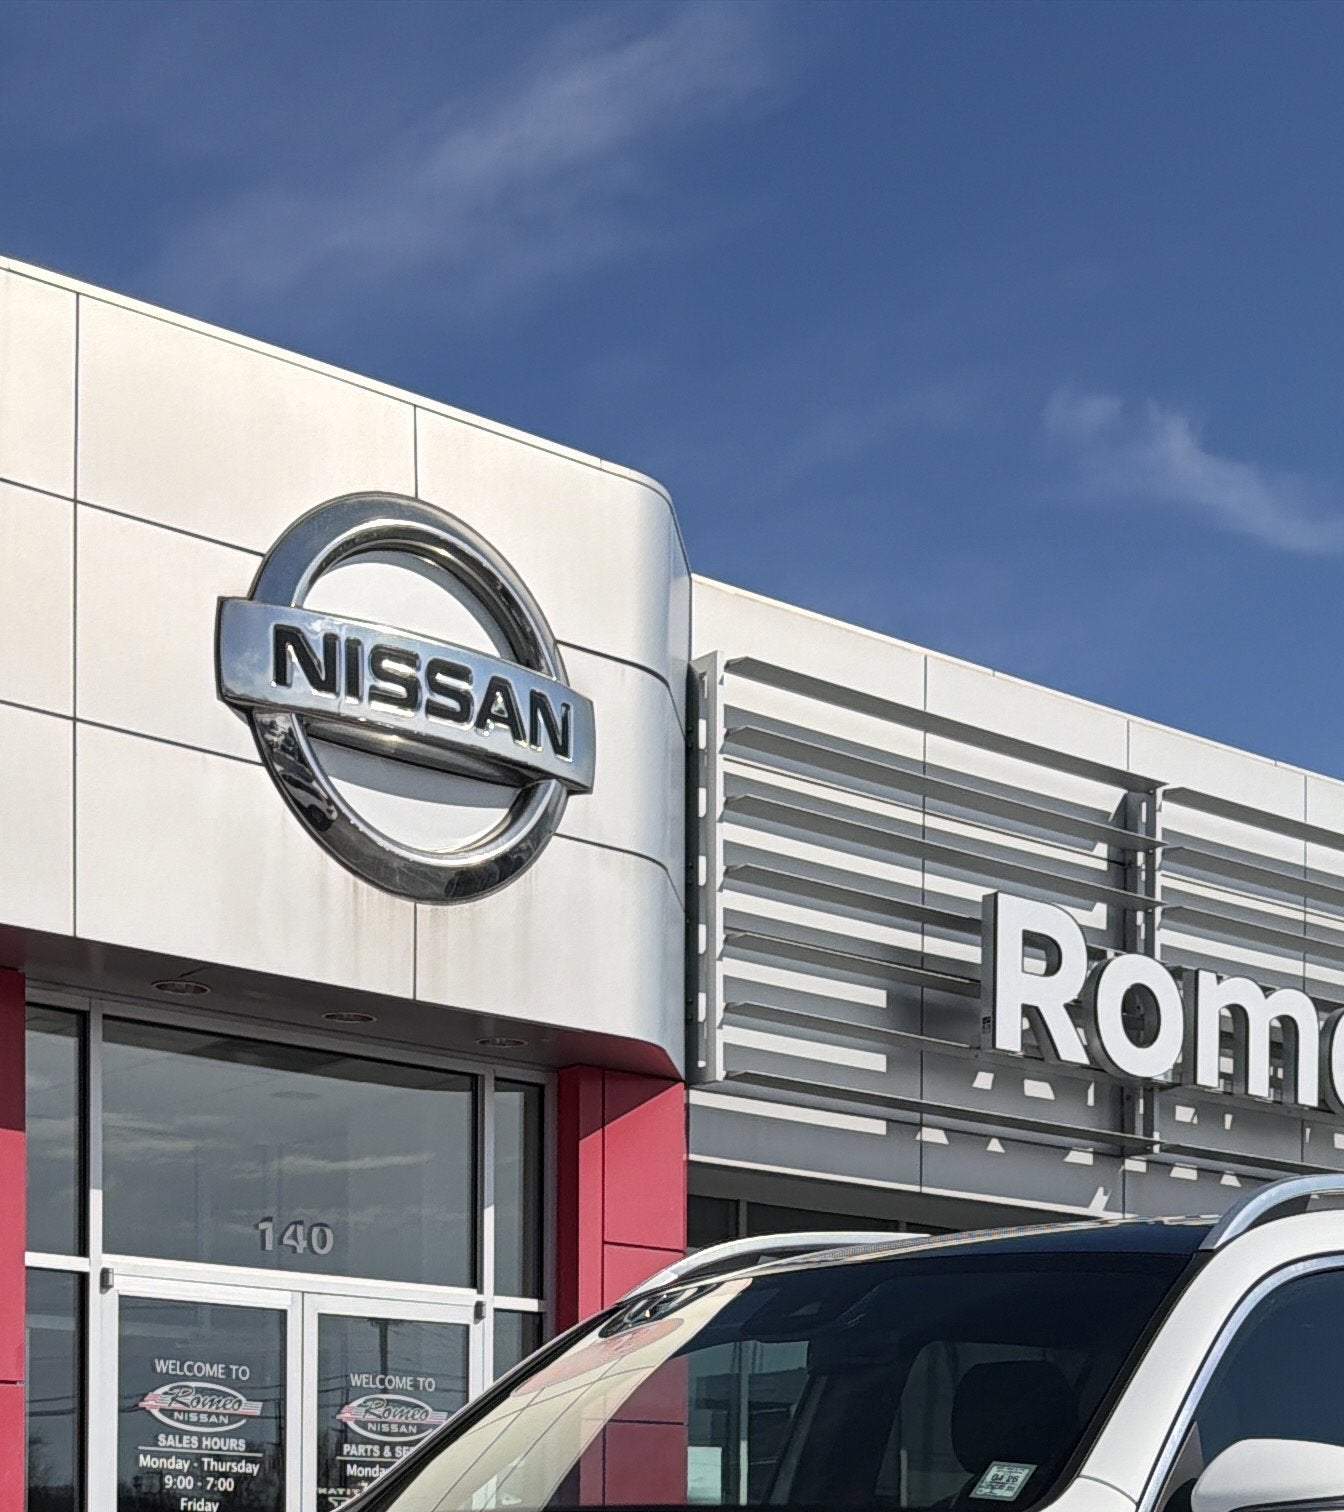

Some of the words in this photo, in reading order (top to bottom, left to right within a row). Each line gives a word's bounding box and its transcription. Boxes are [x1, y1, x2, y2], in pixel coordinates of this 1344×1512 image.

[271, 623, 574, 763] NISSAN
[256, 1216, 334, 1256] 140
[155, 1358, 226, 1379] WELCOME
[230, 1365, 250, 1381] TO
[350, 1373, 414, 1390] WELCOME
[417, 1377, 436, 1392] TO
[166, 1385, 244, 1412] Romeo
[173, 1411, 229, 1424] NISSAN
[361, 1397, 431, 1421] Romeo
[367, 1423, 417, 1433] NISSAN
[157, 1433, 198, 1449] SALES
[202, 1437, 246, 1451] HOURS
[343, 1444, 380, 1457] PARTS
[383, 1445, 392, 1458] &
[138, 1454, 190, 1472] Monday
[201, 1458, 260, 1476] Thursday
[164, 1475, 194, 1489] 9:00
[206, 1477, 235, 1491] 7:00
